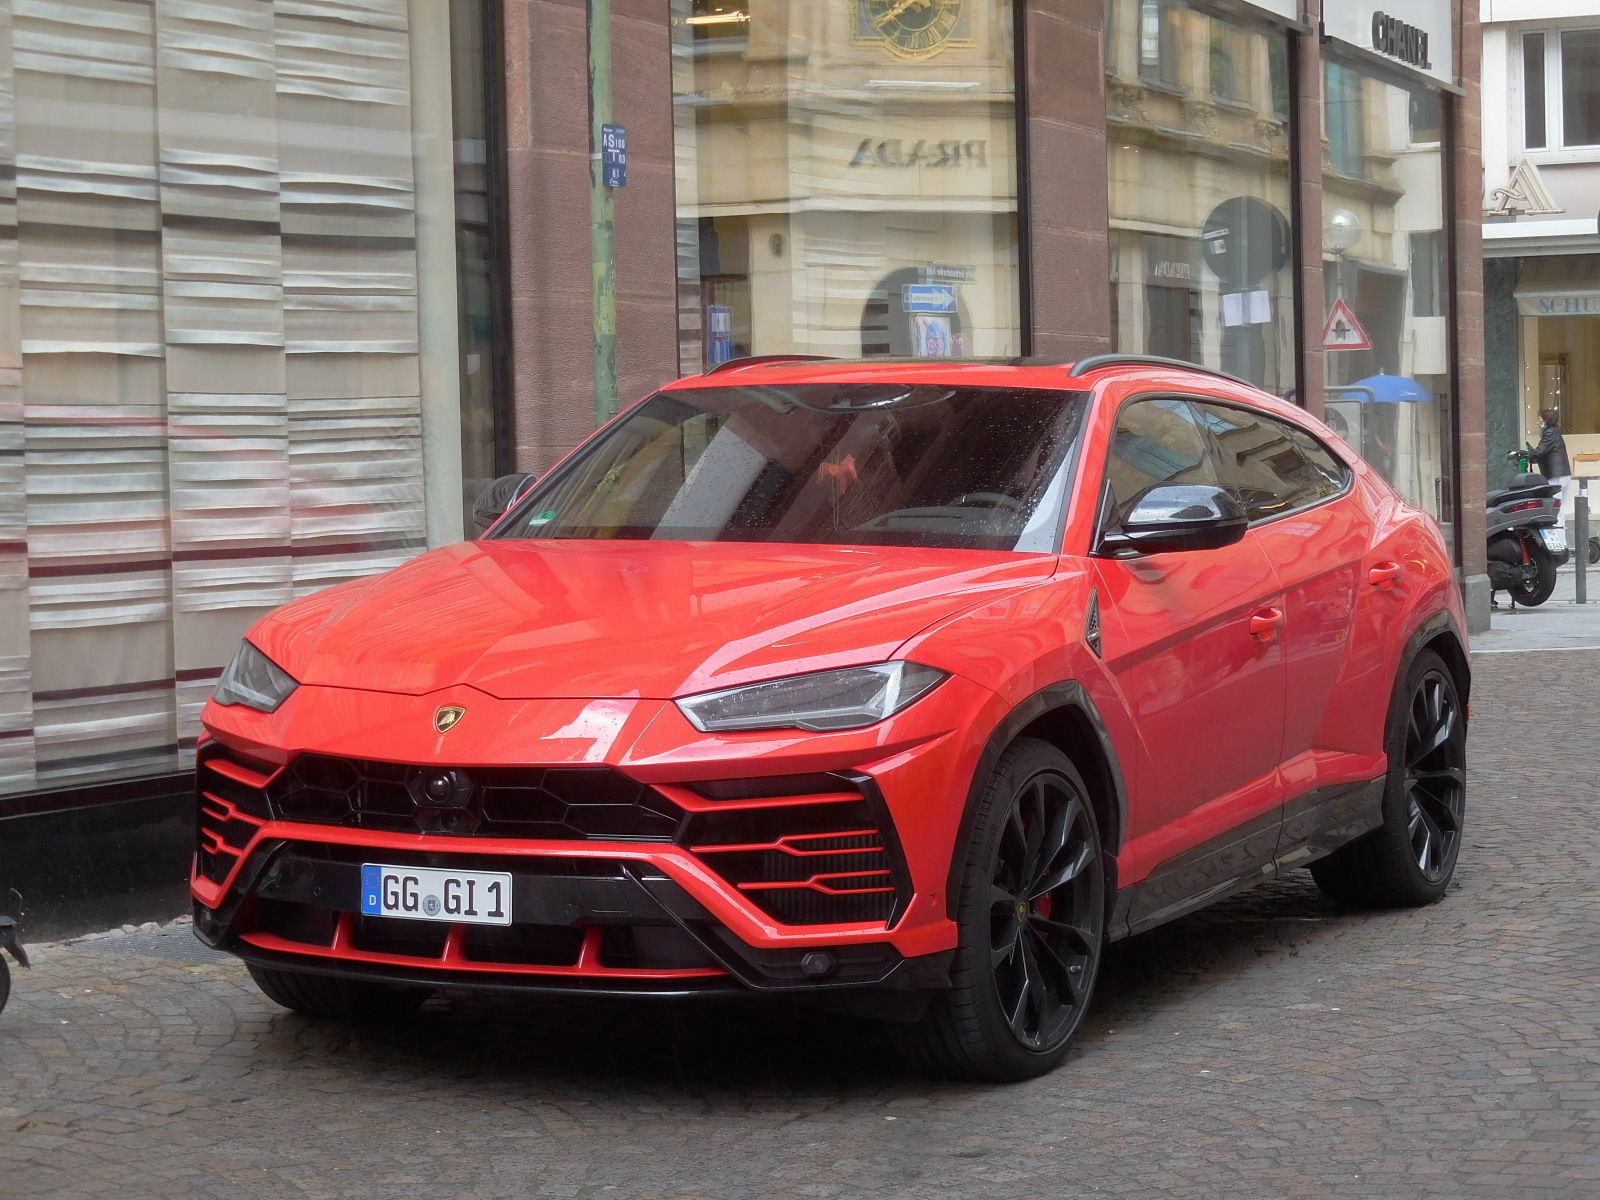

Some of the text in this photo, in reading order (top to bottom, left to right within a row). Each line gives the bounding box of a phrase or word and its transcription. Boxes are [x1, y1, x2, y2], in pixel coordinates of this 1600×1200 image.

[1372, 10, 1432, 70] CHANEL
[1537, 297, 1600, 314] SCHU
[369, 894, 377, 906] D
[383, 874, 504, 918] GG GI 1
